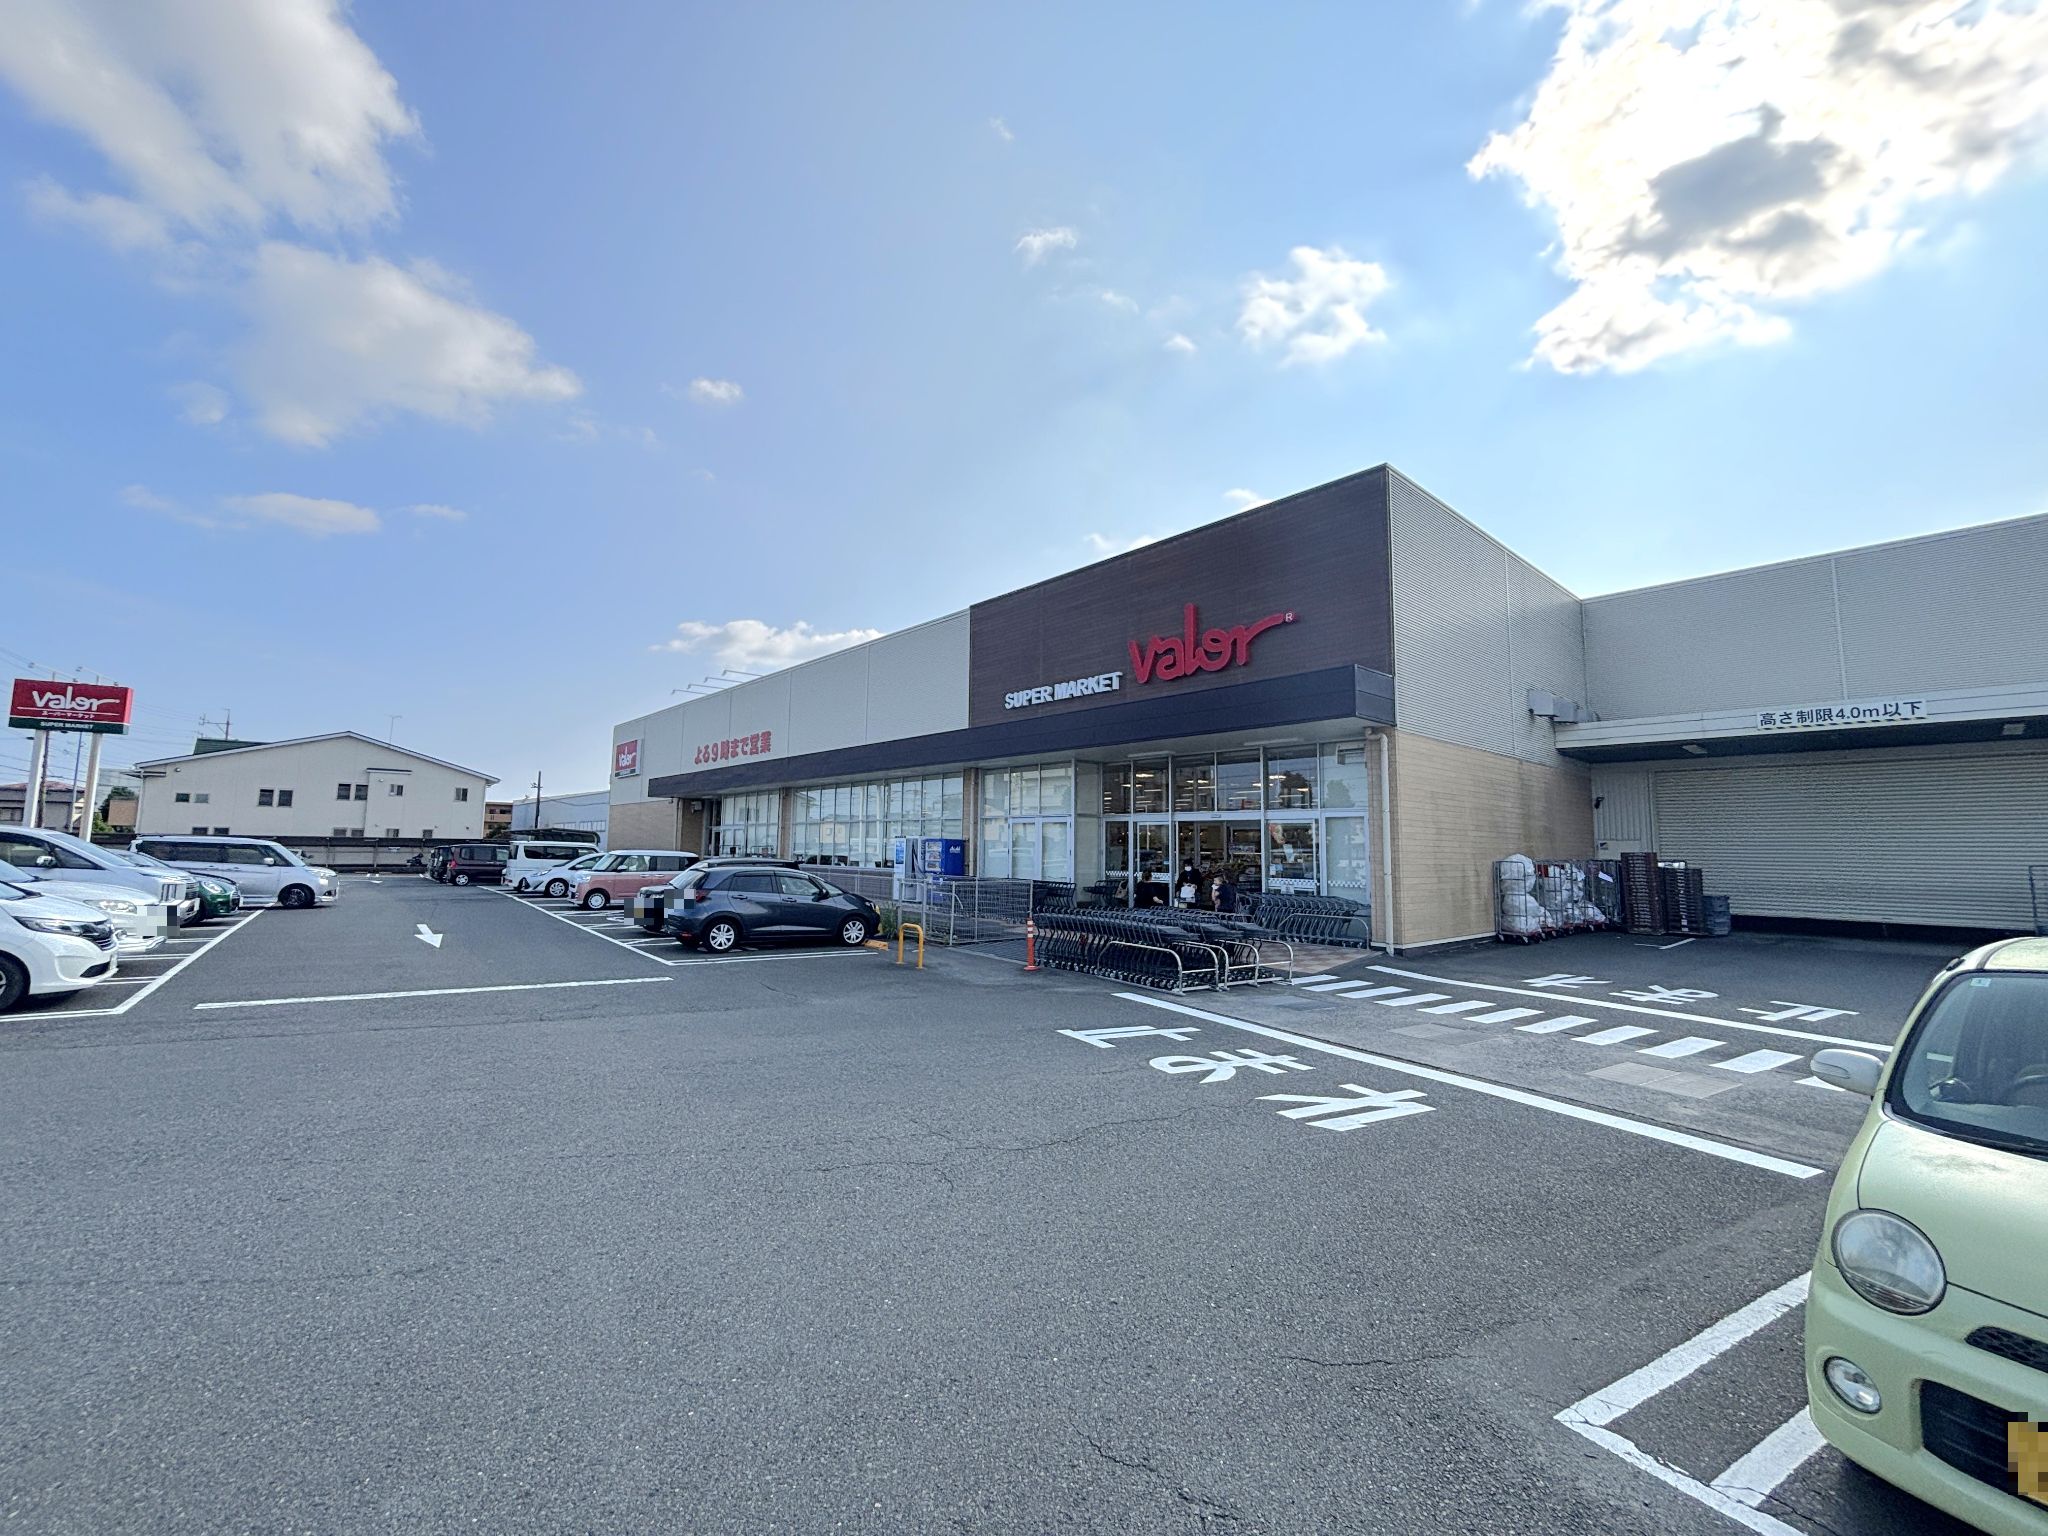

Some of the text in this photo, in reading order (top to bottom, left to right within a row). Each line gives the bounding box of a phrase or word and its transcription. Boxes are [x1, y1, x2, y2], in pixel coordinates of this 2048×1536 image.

[1128, 603, 1284, 684] valor
[1004, 672, 1123, 709] SUPER MARKET
[41, 710, 95, 719] スーパーマーケット
[1760, 701, 1923, 727] 高さ制限4.0m以下
[694, 730, 771, 765] よる9時まで営業
